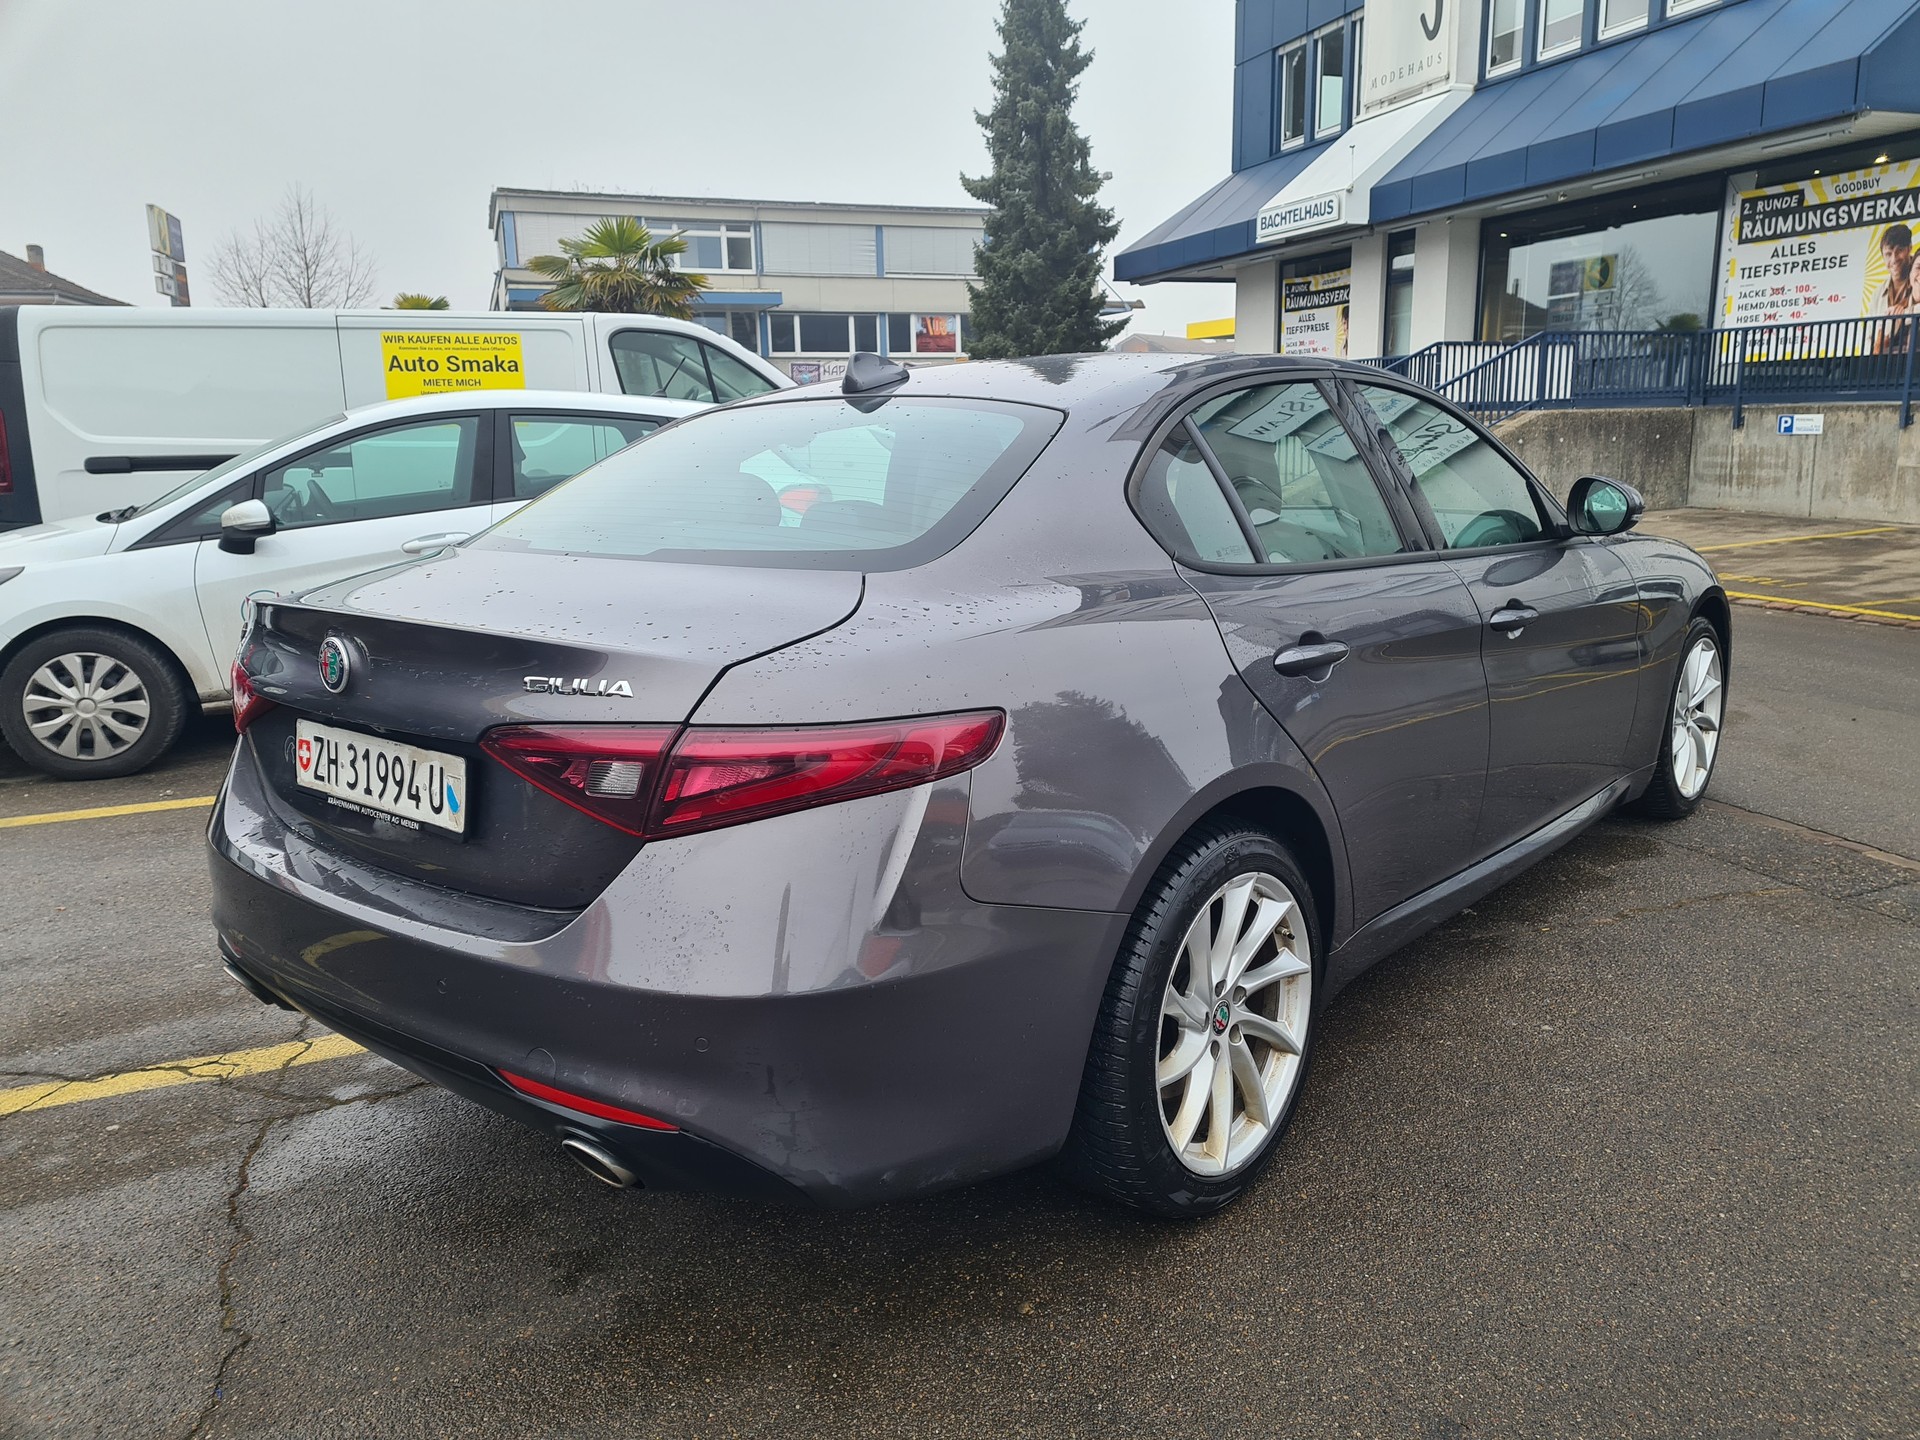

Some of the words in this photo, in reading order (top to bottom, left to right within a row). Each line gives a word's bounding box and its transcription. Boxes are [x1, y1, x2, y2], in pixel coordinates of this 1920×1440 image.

[1370, 52, 1442, 90] MODEHAUS
[1834, 177, 1882, 195] GOODBUY
[1756, 194, 1799, 213] RUNDE
[1260, 199, 1334, 231] BACHTELHAUS
[1741, 192, 1920, 240] RÄUMUNGSVERKA
[1770, 241, 1816, 260] ALLES
[1740, 254, 1849, 280] TIEFSTPREISE
[1285, 287, 1350, 310] RÄUMUNGSVERK
[1738, 288, 1768, 300] JACKE
[1298, 313, 1316, 323] ALLES
[1736, 314, 1760, 324] HOSE
[383, 335, 405, 344] WIR
[408, 335, 451, 344] KAUFEN
[454, 336, 480, 345] ALLE
[483, 336, 518, 345] AUTOS
[388, 355, 440, 373] Auto
[446, 354, 520, 373] Smaka
[423, 379, 453, 387] MIETE
[456, 379, 482, 387] MICH
[1780, 416, 1792, 433] P
[523, 676, 634, 698] GIULIA
[361, 806, 391, 823] AUTOCENTER
[391, 815, 400, 824] AG
[400, 819, 419, 831] MEILEN
